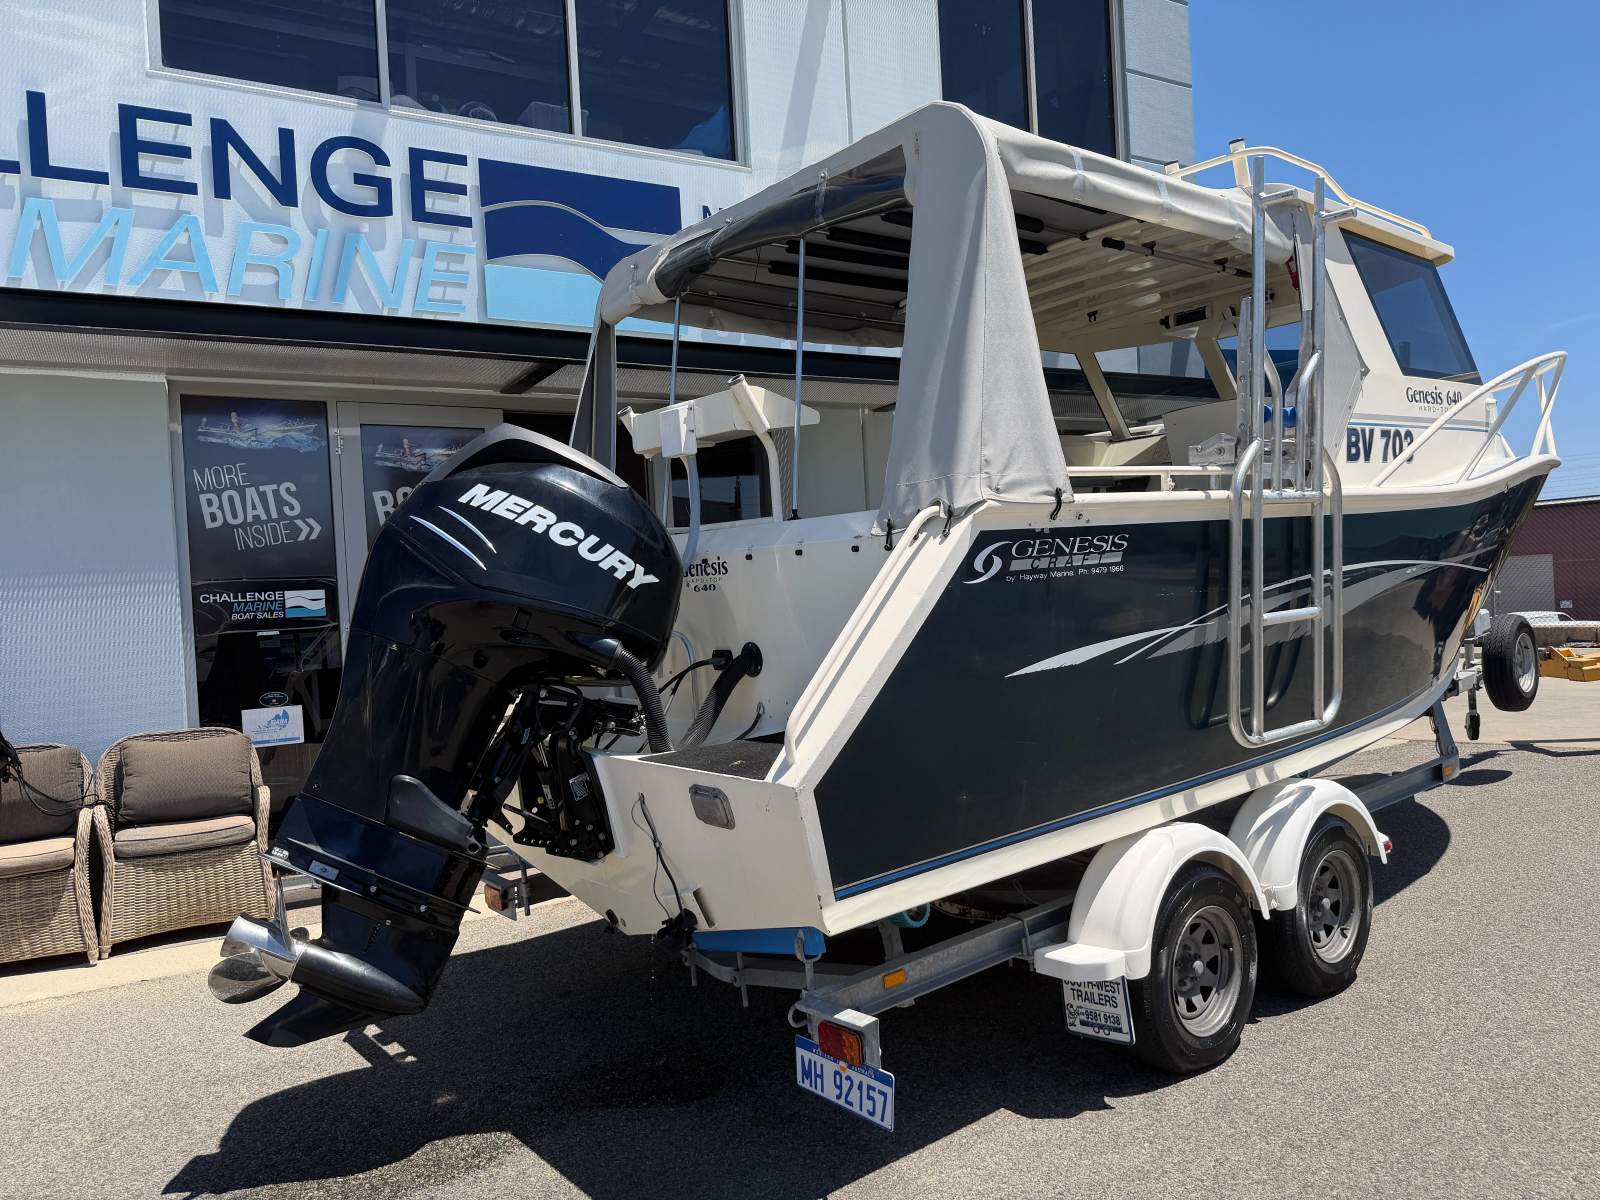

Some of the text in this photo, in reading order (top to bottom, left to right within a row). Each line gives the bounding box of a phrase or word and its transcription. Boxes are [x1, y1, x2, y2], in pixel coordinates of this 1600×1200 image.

[0, 91, 473, 228] LENGE
[6, 197, 476, 315] MARINE
[1406, 386, 1462, 406] Genesis 640
[1346, 428, 1375, 462] BV
[193, 462, 251, 491] MORE
[199, 482, 301, 529] BOATS
[234, 521, 295, 550] INSIDE
[458, 483, 660, 589] MERCURY
[1011, 534, 1129, 558] GENESIS
[683, 556, 728, 577] enesis
[1020, 573, 1048, 581] Hayway
[199, 591, 284, 604] CHALLENGE
[693, 583, 717, 592] 640
[231, 611, 284, 620] BOAT SALES
[232, 601, 284, 612] MARINE
[1070, 988, 1119, 1009] TRAILERS
[1085, 1010, 1102, 1023] 9581
[1103, 1013, 1121, 1026] 9138
[800, 1055, 888, 1122] MH 92157
